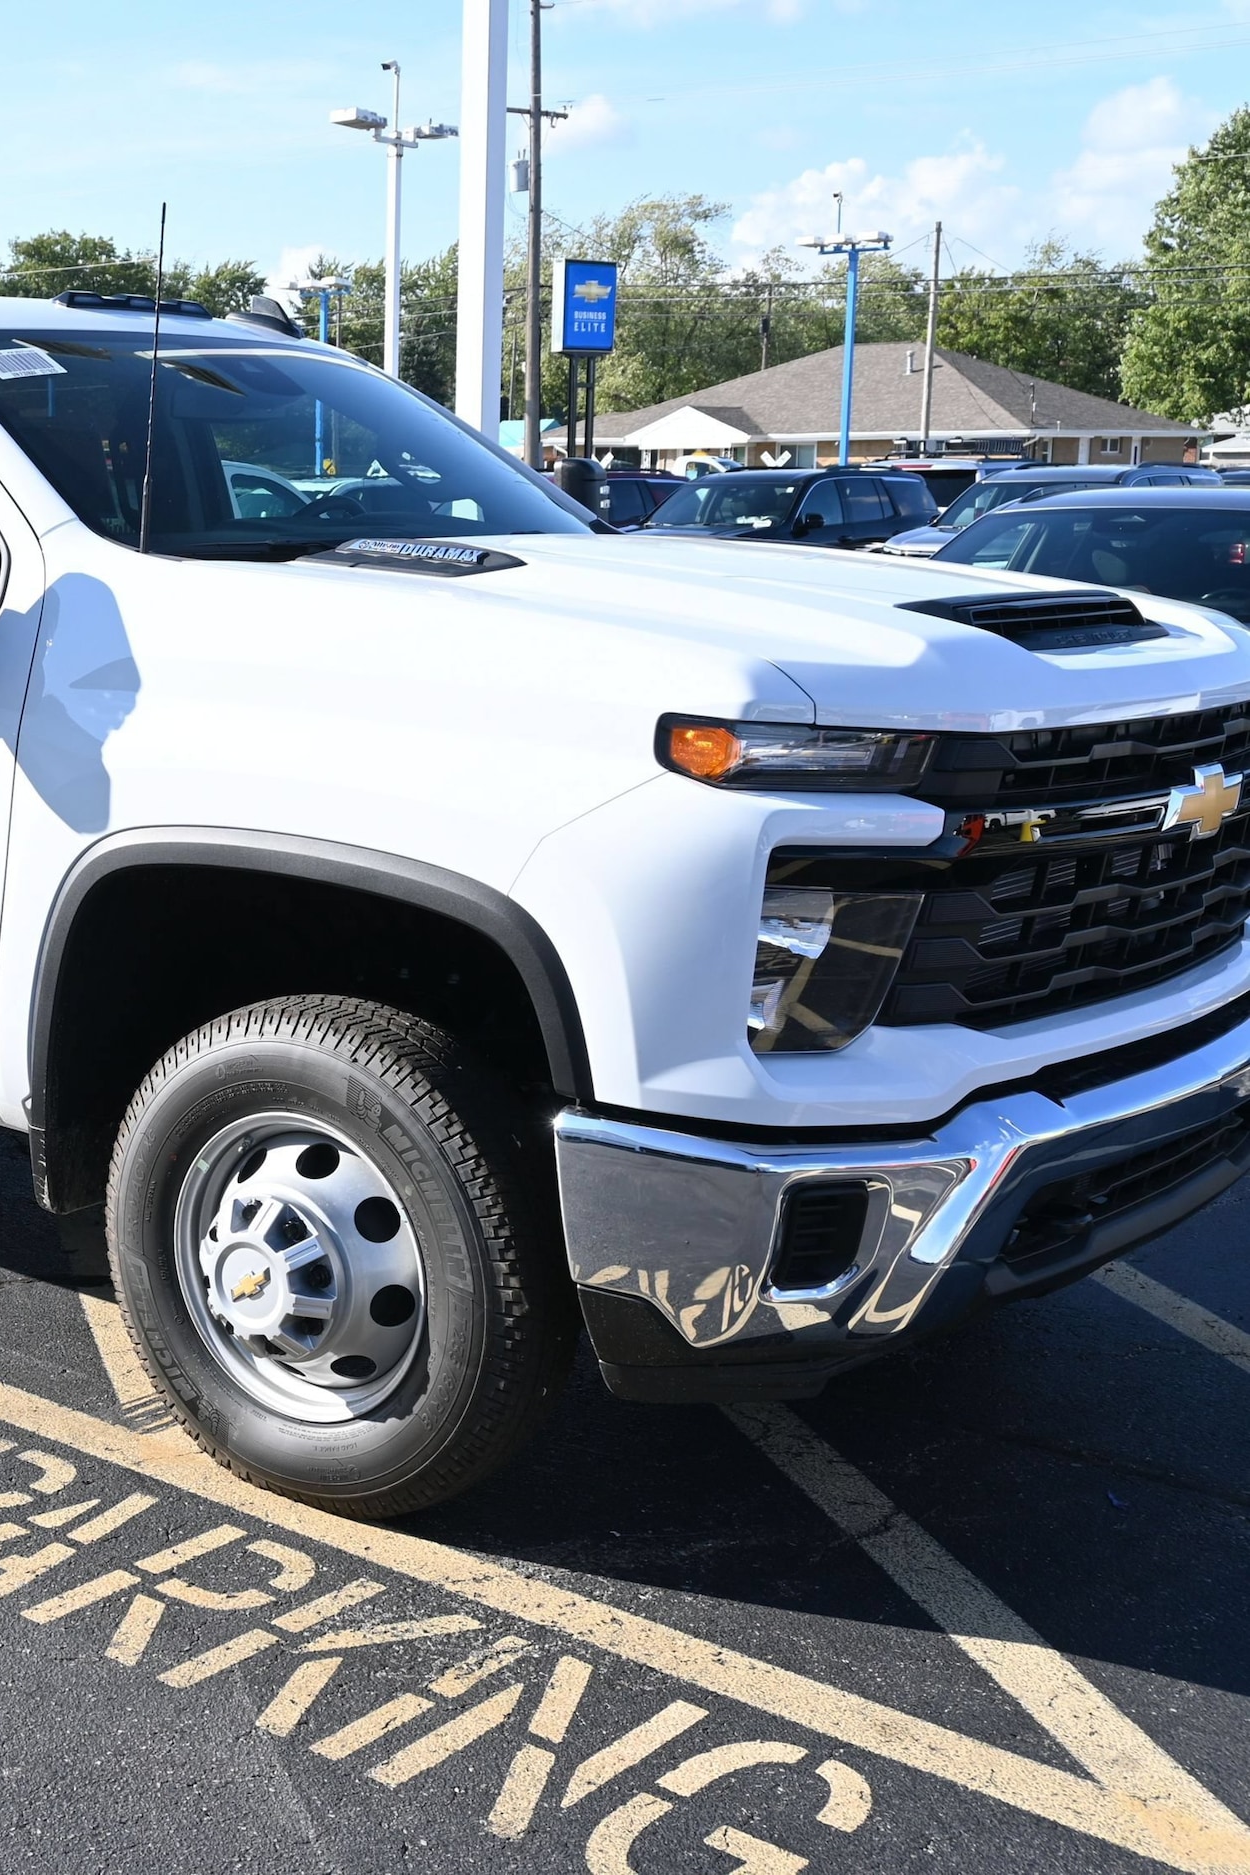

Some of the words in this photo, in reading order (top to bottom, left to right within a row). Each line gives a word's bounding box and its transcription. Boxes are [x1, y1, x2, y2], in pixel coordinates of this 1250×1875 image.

[574, 311, 607, 320] BUSINESS
[574, 322, 607, 333] ELITE
[400, 543, 484, 564] DURAMAX
[382, 1124, 471, 1290] MICHELIN
